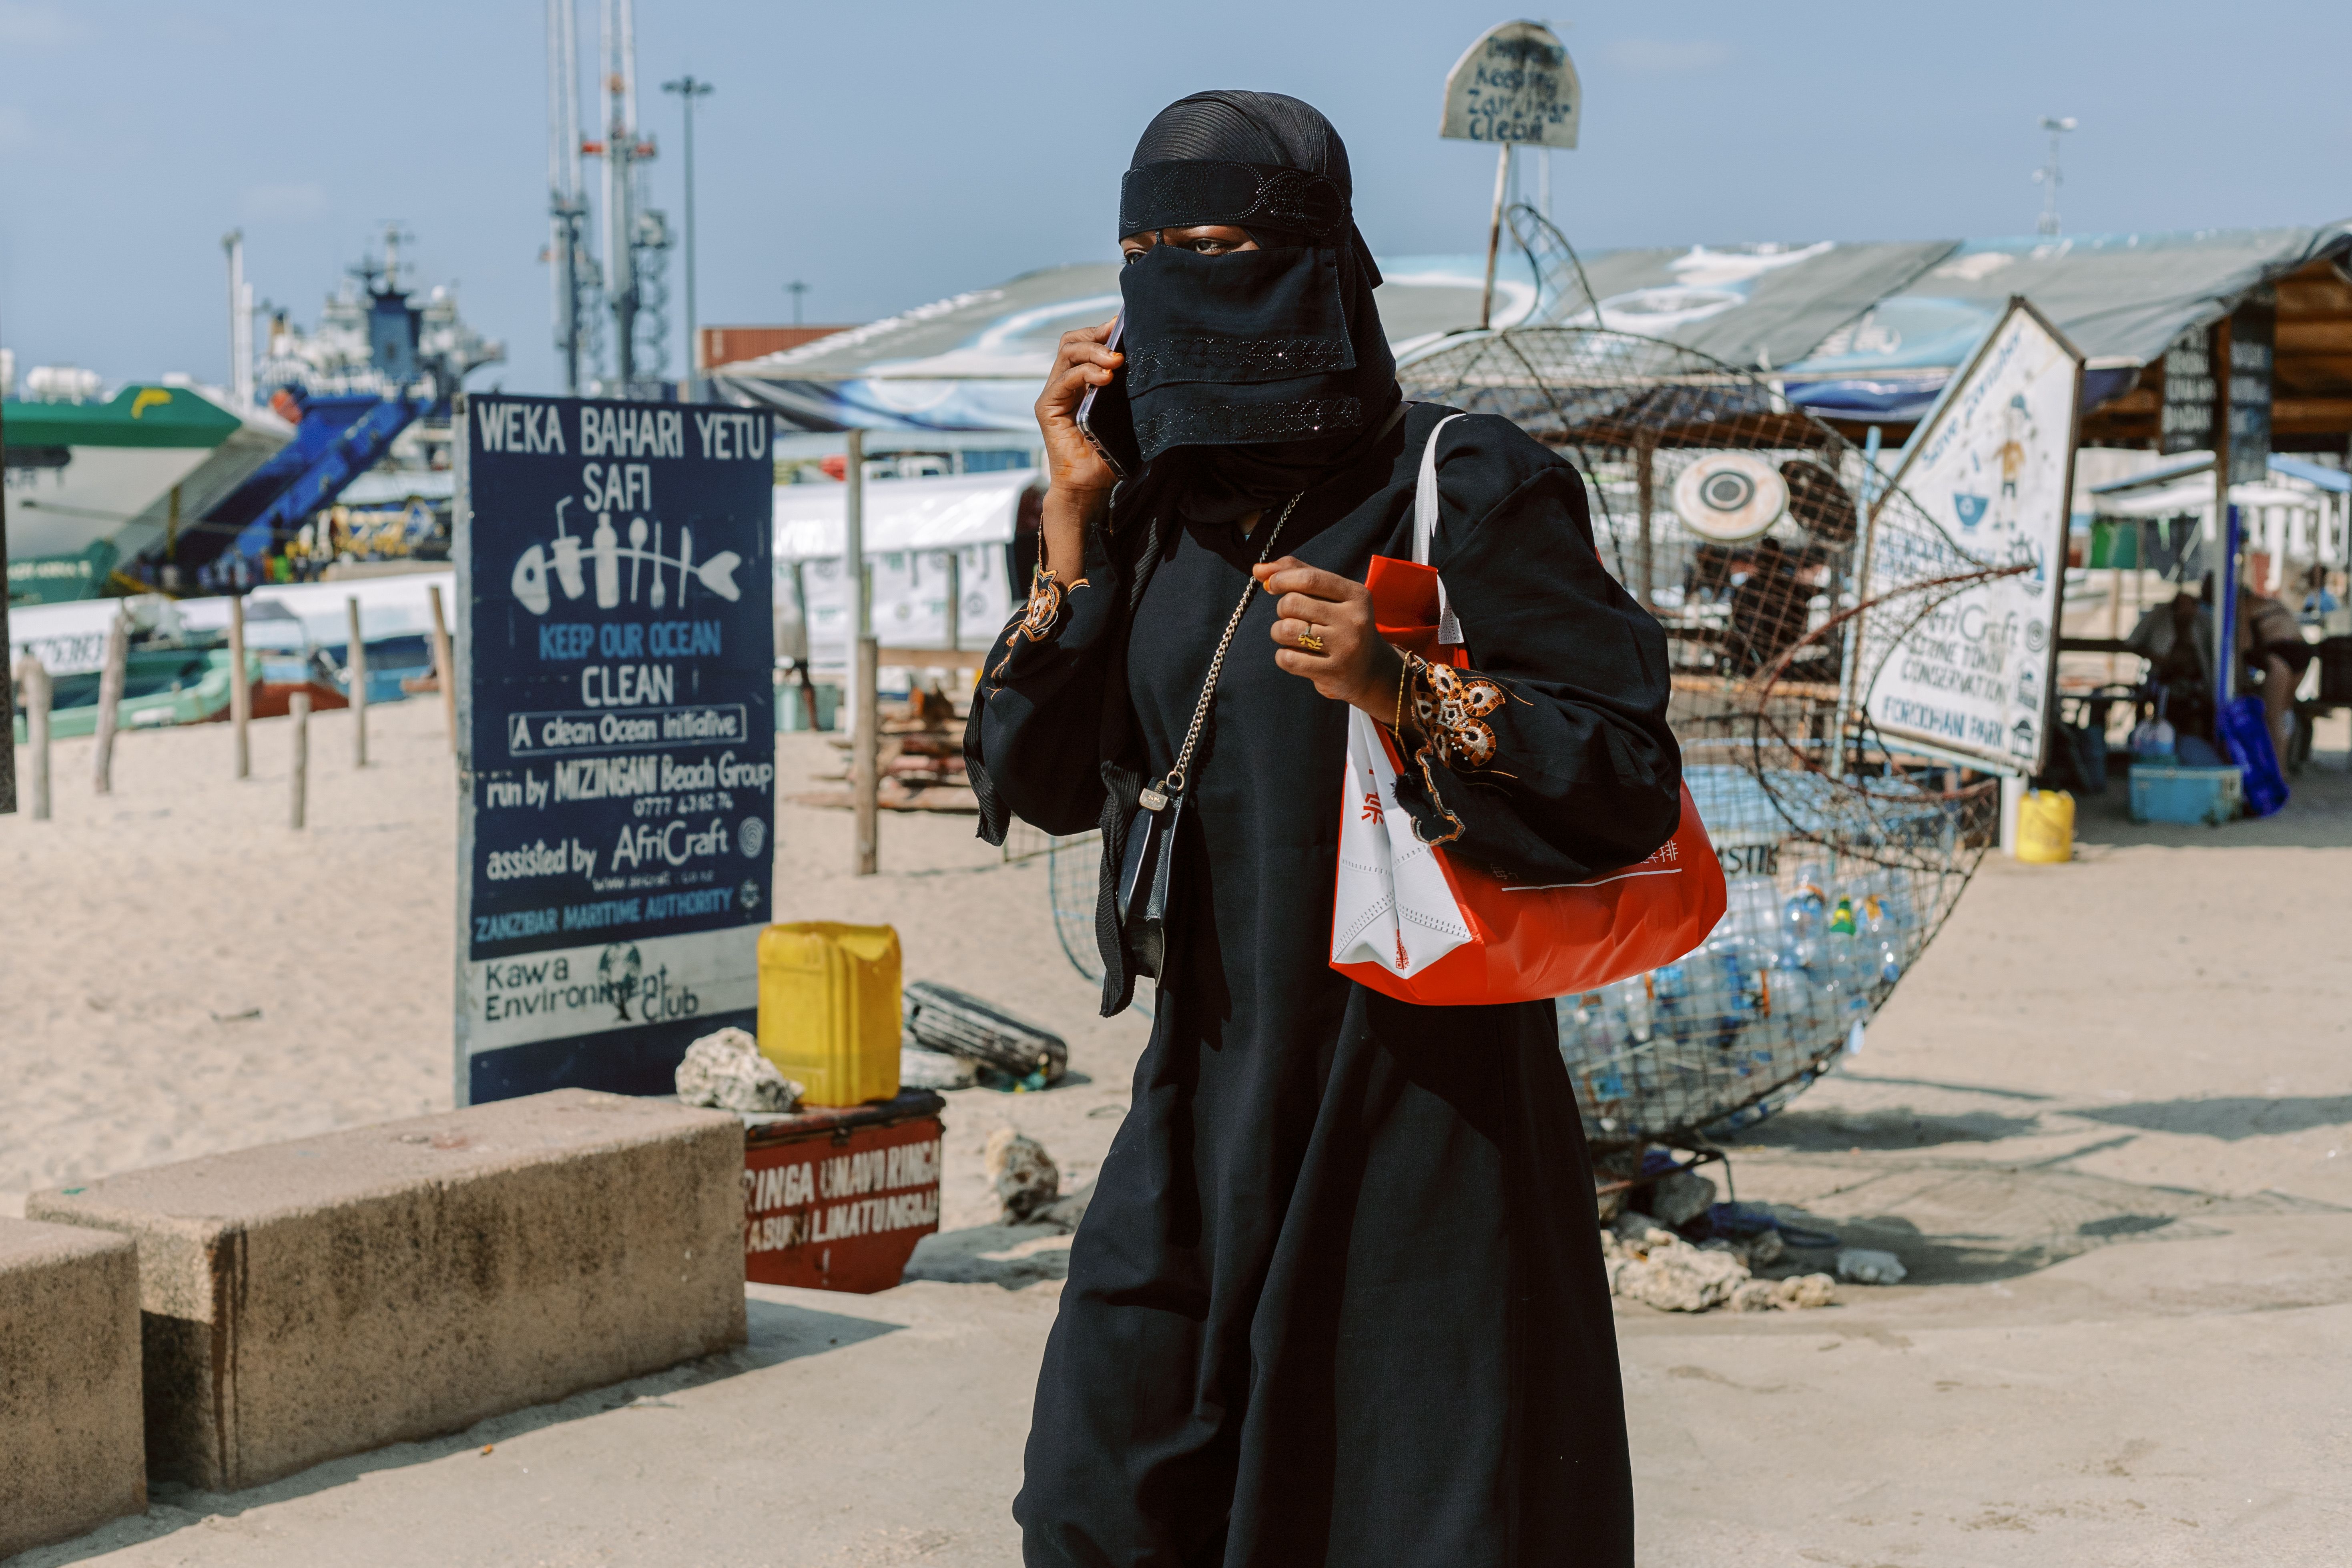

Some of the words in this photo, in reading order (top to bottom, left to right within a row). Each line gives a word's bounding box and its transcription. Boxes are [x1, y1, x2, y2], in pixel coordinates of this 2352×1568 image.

[478, 402, 565, 454] WEKA
[580, 406, 683, 458] BAHARI
[695, 412, 765, 459] YETU
[583, 463, 651, 512] SAFI
[539, 623, 595, 660] KEEP
[600, 622, 643, 659] OUR
[649, 620, 721, 657] OCEAN
[582, 664, 673, 707] CLEAN
[512, 715, 533, 749] A
[542, 717, 596, 747] clean
[600, 713, 657, 742] Ocean
[487, 779, 522, 809] run
[526, 767, 549, 810] by
[661, 754, 715, 793] Beach
[718, 751, 773, 793] Group
[487, 838, 566, 880] assisted
[572, 839, 596, 878] by
[611, 817, 728, 872] AfriCraft
[475, 907, 557, 942] ZANZIBAR
[564, 897, 641, 931] MARITIME
[645, 887, 733, 920] AUTHORITY
[485, 958, 568, 990] Kawa
[642, 986, 699, 1024] Club
